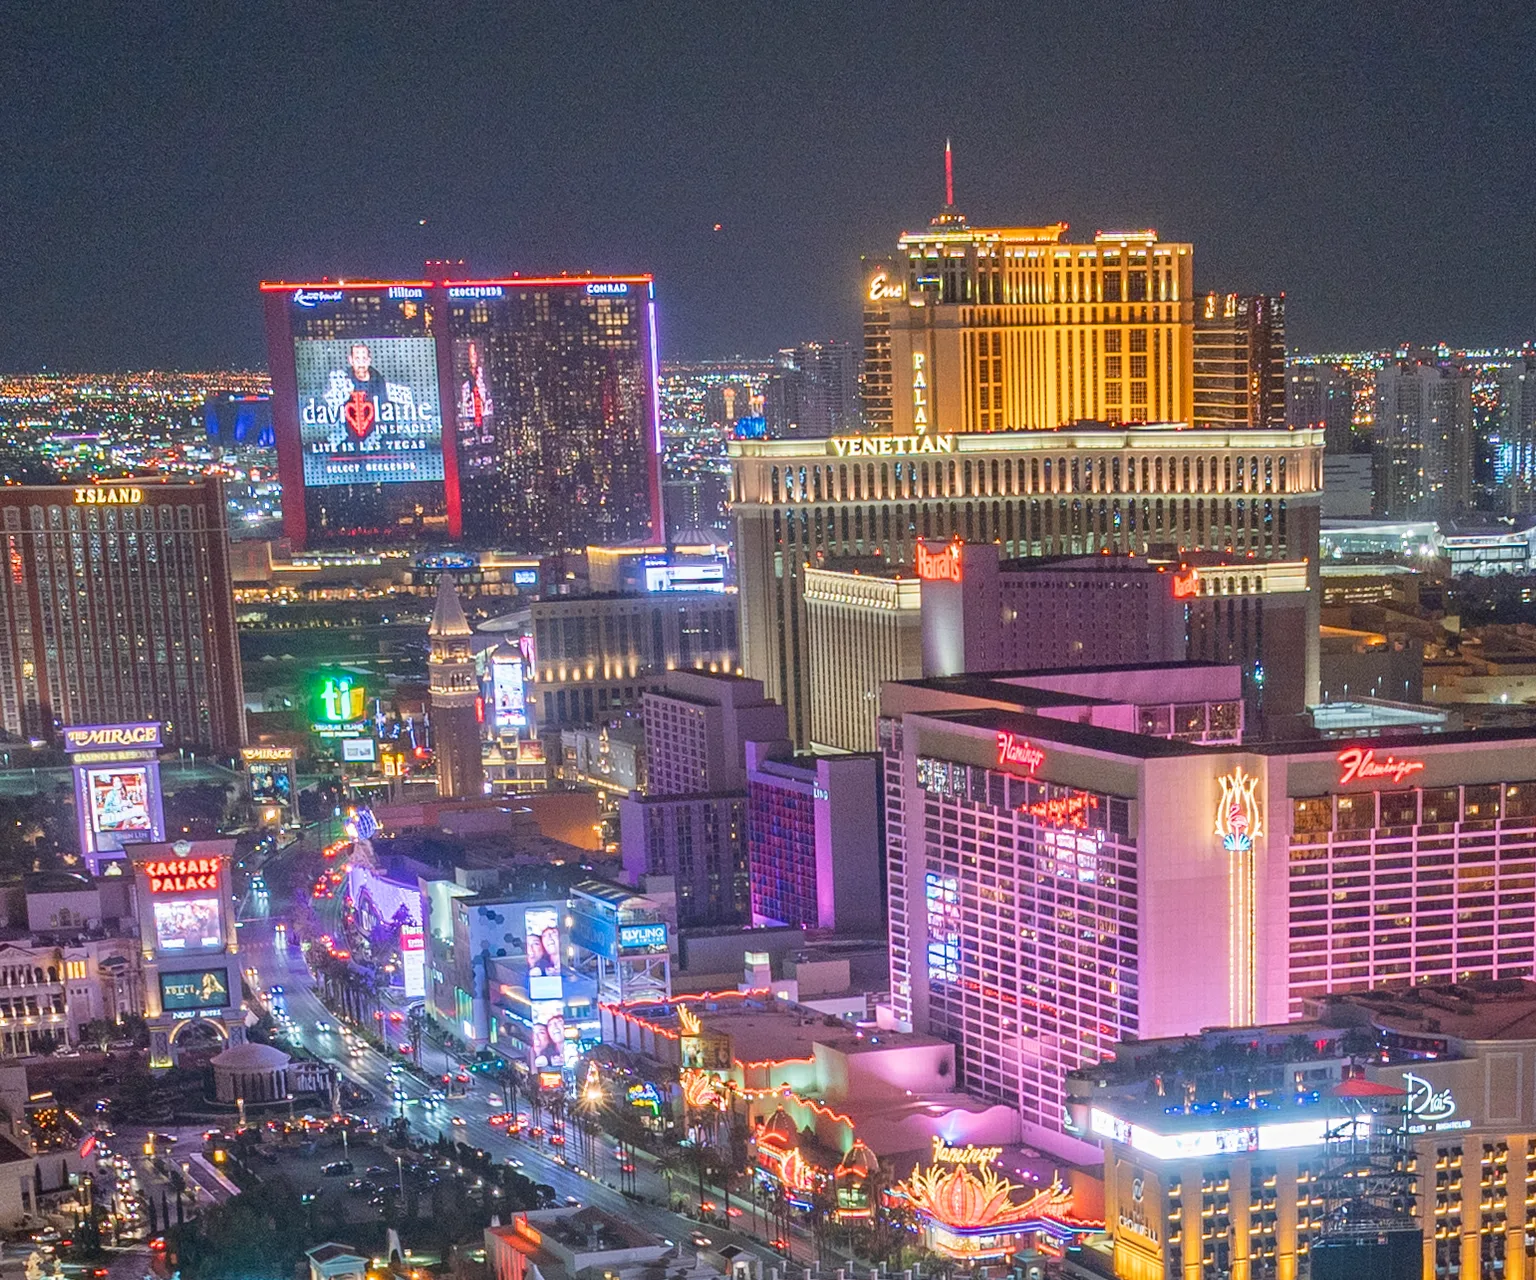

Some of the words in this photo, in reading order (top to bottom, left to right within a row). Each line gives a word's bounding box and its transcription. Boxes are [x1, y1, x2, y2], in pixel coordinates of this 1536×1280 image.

[388, 286, 422, 298] Hilton
[586, 283, 628, 294] CONRAD
[312, 442, 339, 453] LIVE
[341, 442, 355, 452] IN
[360, 440, 381, 452] LAS
[386, 439, 426, 450] VEGAS
[831, 435, 953, 457] VENETIAN
[326, 464, 360, 474] SELECT
[74, 487, 142, 504] ISLAND
[76, 727, 156, 746] MIRAGE
[997, 733, 1044, 774] Flamingo
[1338, 749, 1424, 785] Flamingo
[146, 858, 220, 876] CAESARS
[151, 874, 218, 893] PALACE
[1402, 1071, 1456, 1121] Drai's
[933, 1135, 1003, 1168] Flamingo
[1118, 1215, 1159, 1244] CROMWELL
